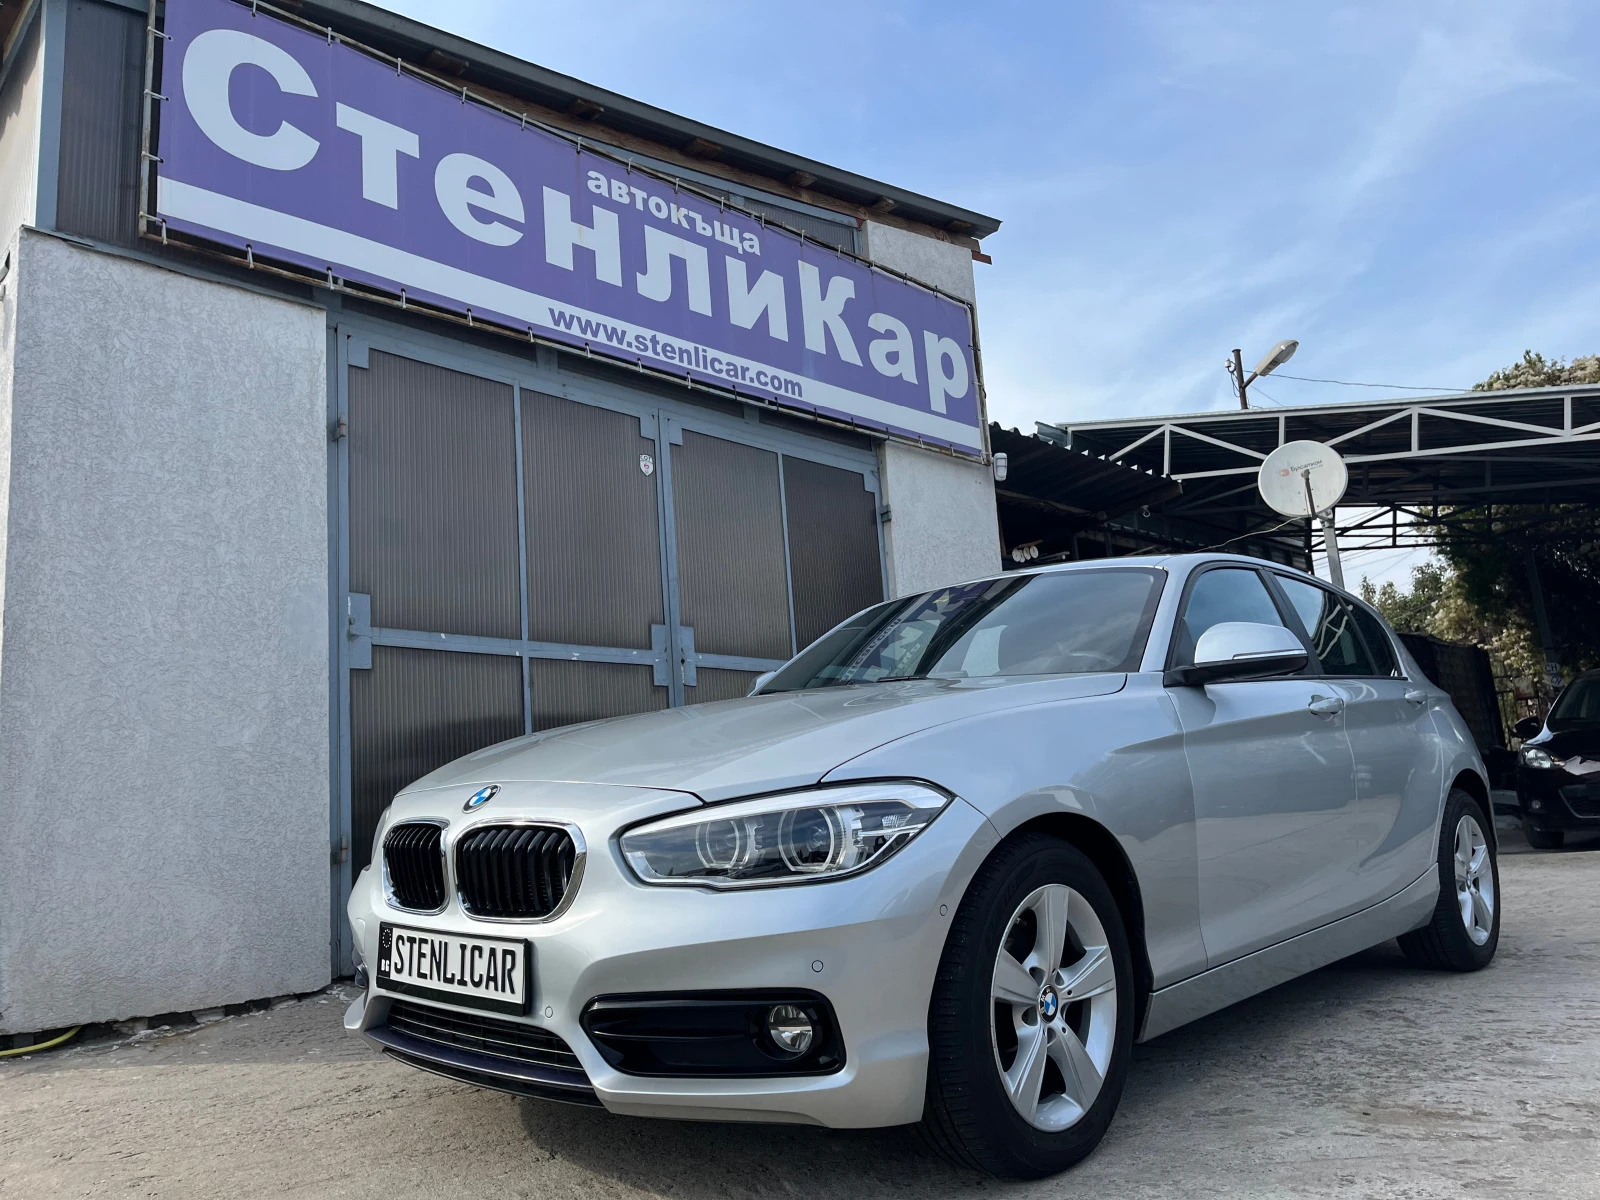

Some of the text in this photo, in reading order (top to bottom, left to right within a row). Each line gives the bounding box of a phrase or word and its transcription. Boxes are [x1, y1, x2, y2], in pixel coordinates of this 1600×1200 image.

[182, 28, 969, 415] СтенлиКар
[586, 170, 761, 256] автокъща
[548, 307, 803, 398] www.stenlicar.com
[380, 958, 390, 972] BG
[393, 934, 516, 995] STENLICAR
